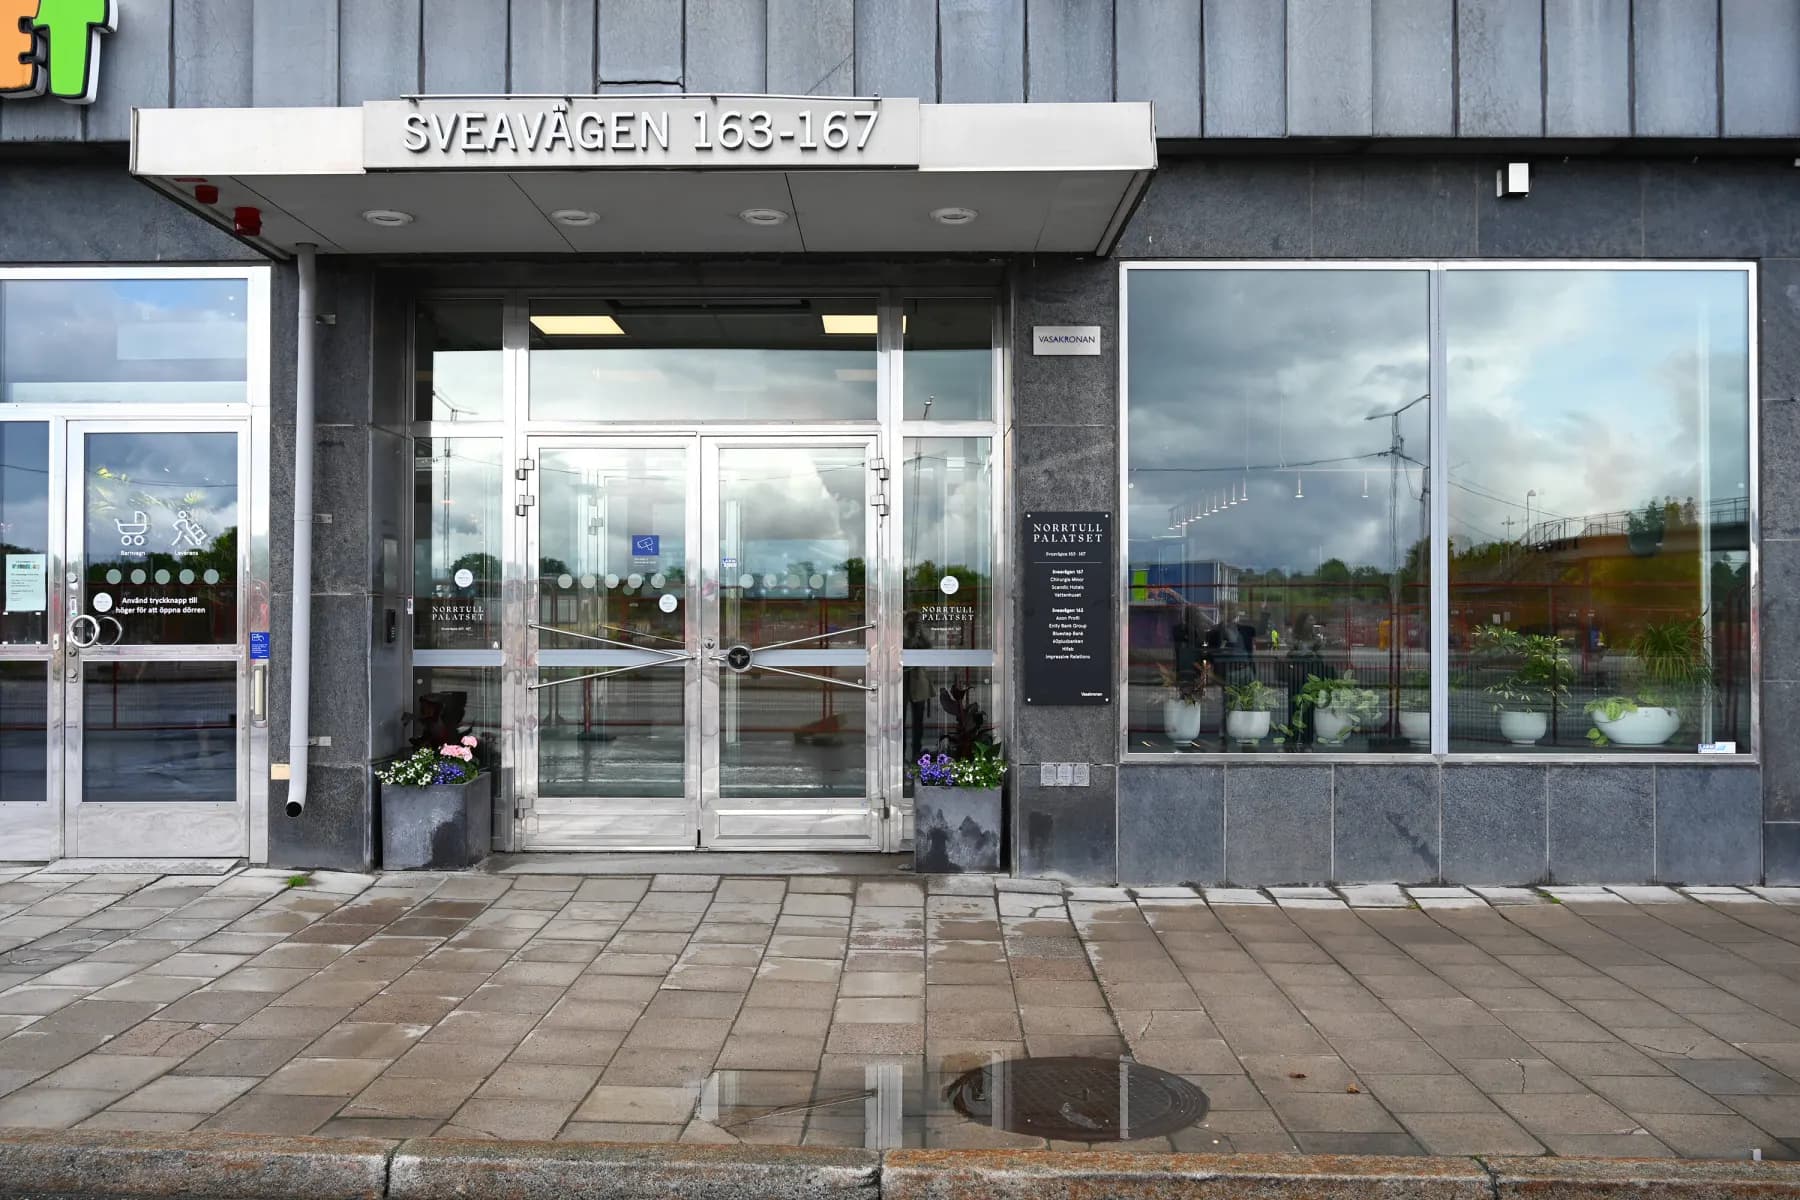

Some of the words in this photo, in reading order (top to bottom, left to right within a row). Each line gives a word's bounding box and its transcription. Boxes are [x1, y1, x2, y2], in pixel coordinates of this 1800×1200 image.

[403, 104, 671, 153] SVEAVÄGEN
[694, 110, 880, 151] 163-167
[1038, 335, 1096, 343] VASAKRONAN
[1033, 523, 1103, 532] NORRTULL
[1033, 533, 1103, 543] PALATSET
[122, 596, 148, 604] Använd
[149, 597, 187, 605] tryckknapp
[188, 596, 198, 604] till
[115, 607, 135, 615] höger
[159, 607, 181, 615] öppna
[182, 606, 206, 614] dörren
[432, 613, 484, 621] PALATSET
